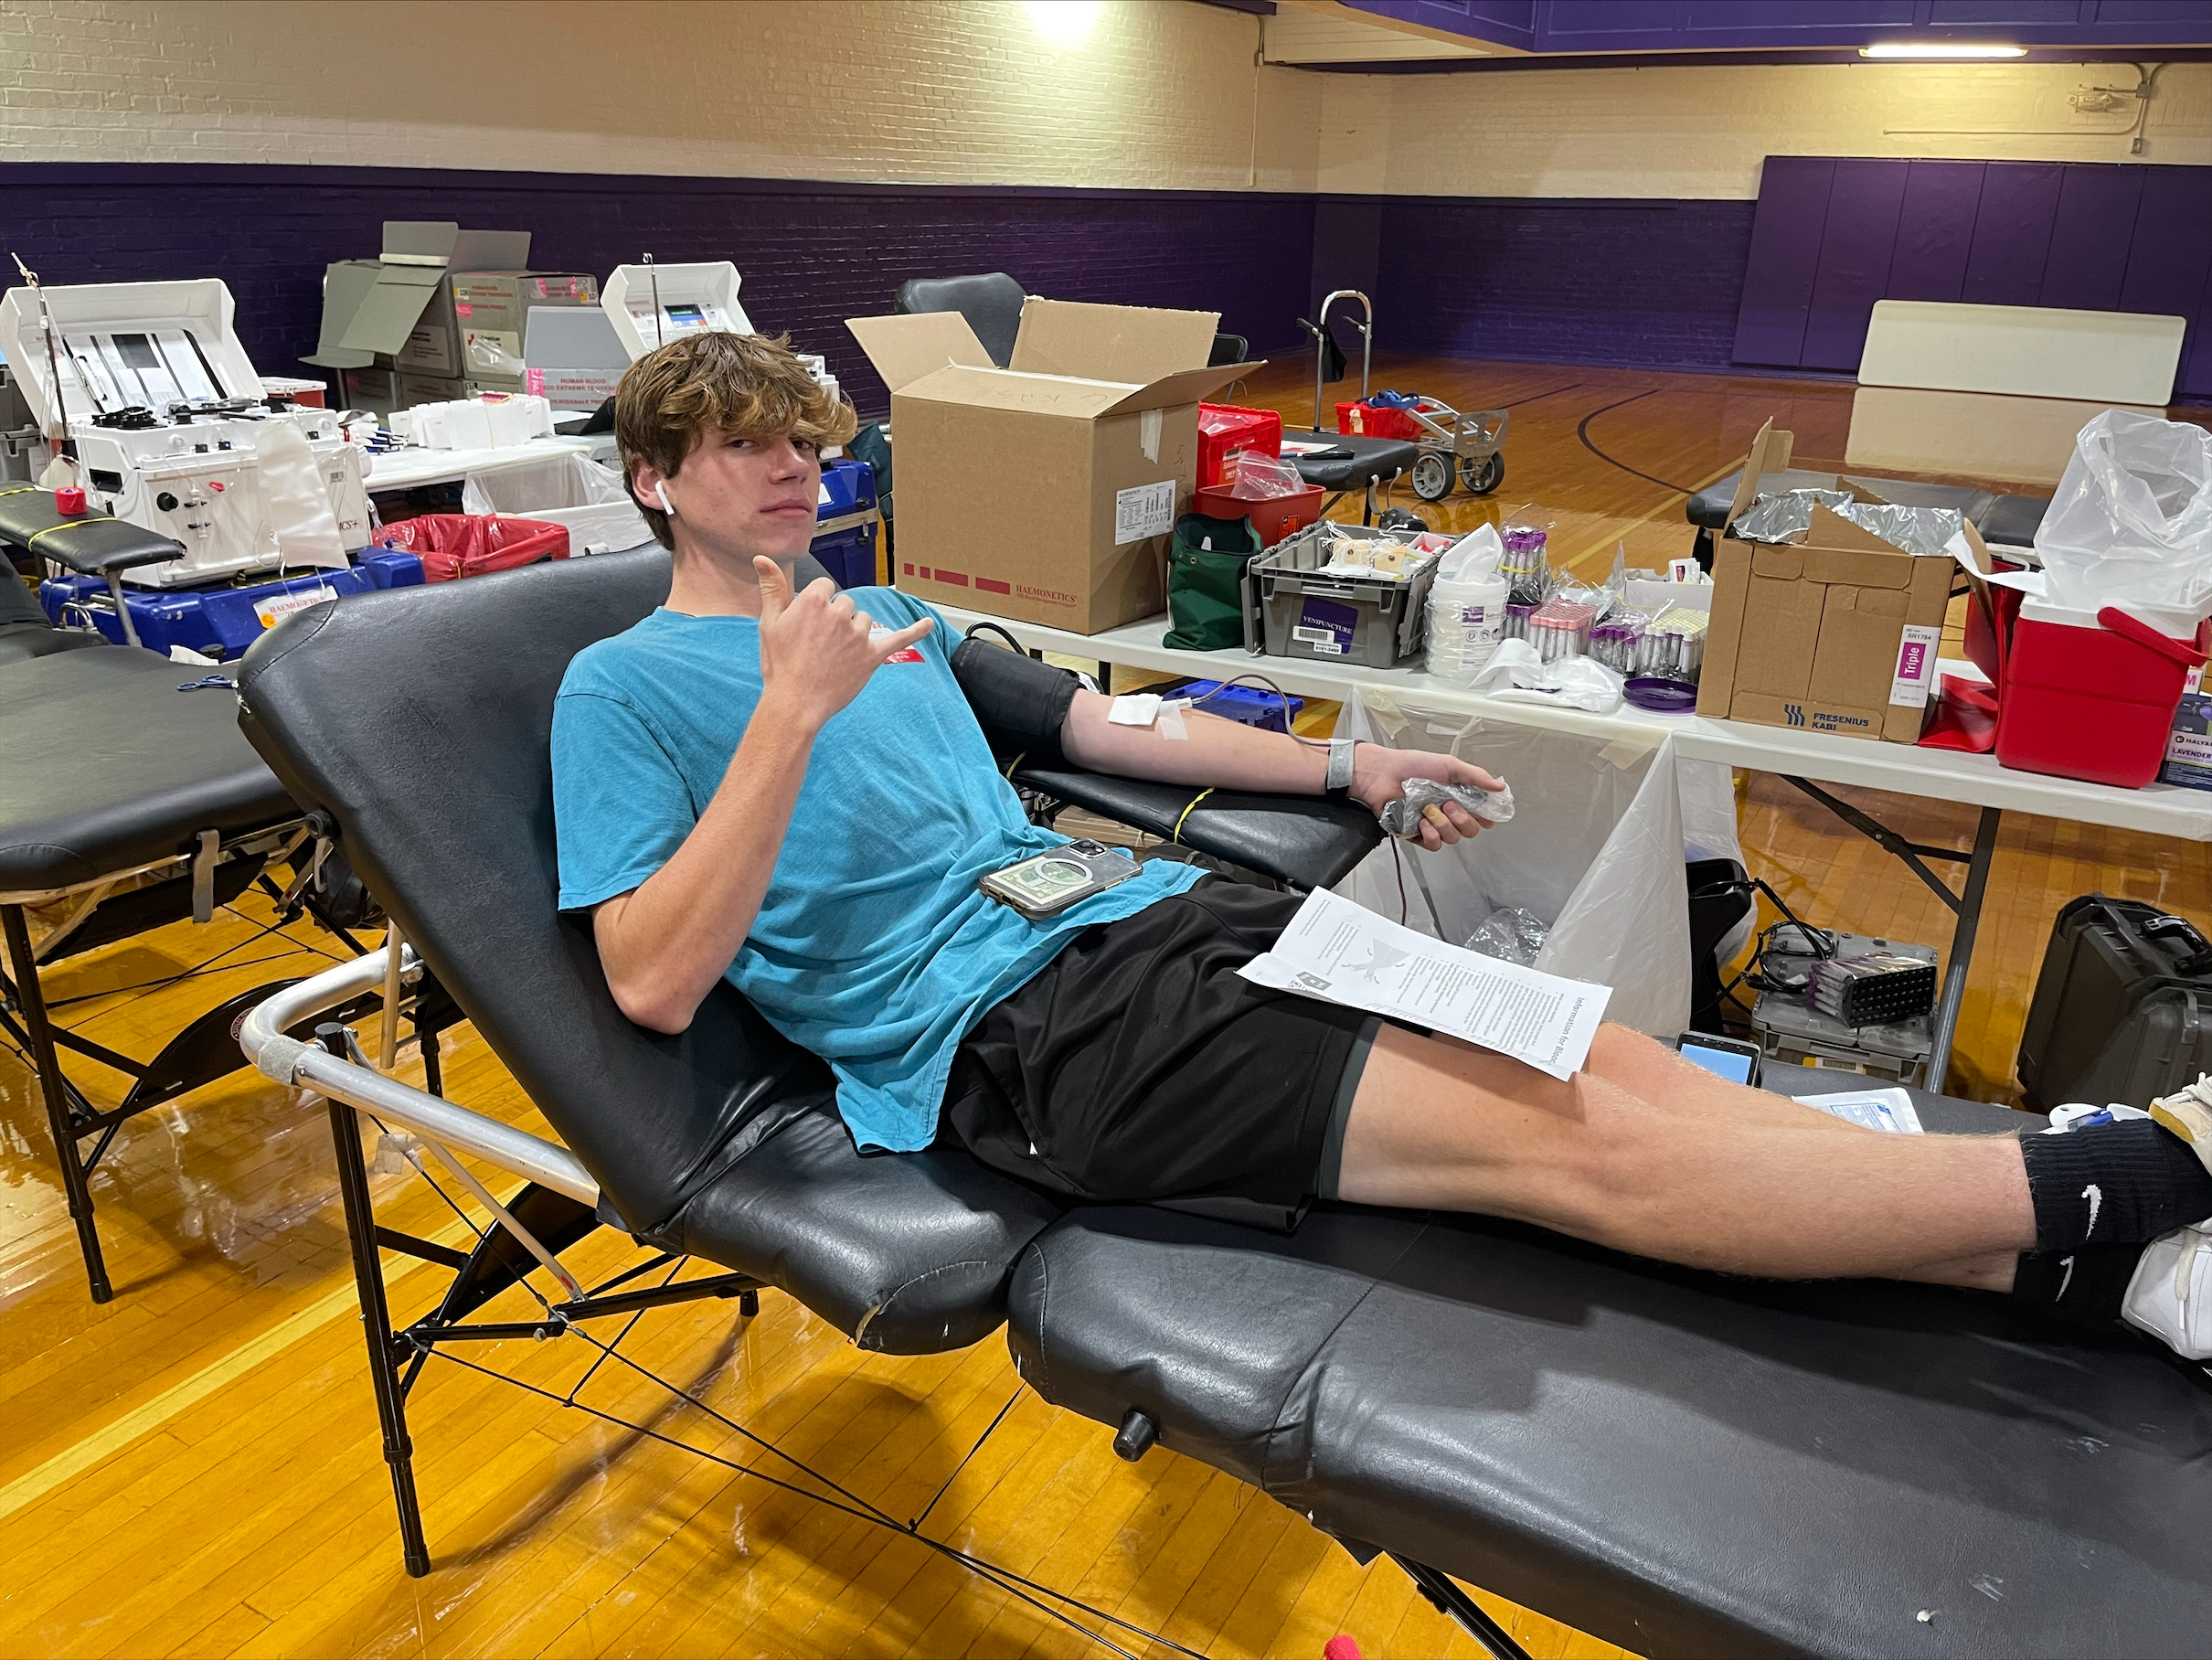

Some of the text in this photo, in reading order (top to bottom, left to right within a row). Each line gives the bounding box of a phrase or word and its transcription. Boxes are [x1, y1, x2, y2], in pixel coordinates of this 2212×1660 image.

[1016, 584, 1077, 603] HAEMONETICS
[1303, 615, 1353, 635] VENIPUNCTURE
[1904, 646, 1920, 675] Triple
[1812, 721, 1837, 731] KABI
[1813, 712, 1869, 727] FRESENIUS
[2172, 748, 2211, 760] LAVENDER
[1562, 996, 1586, 1036] Information
[1558, 1035, 1569, 1047] for
